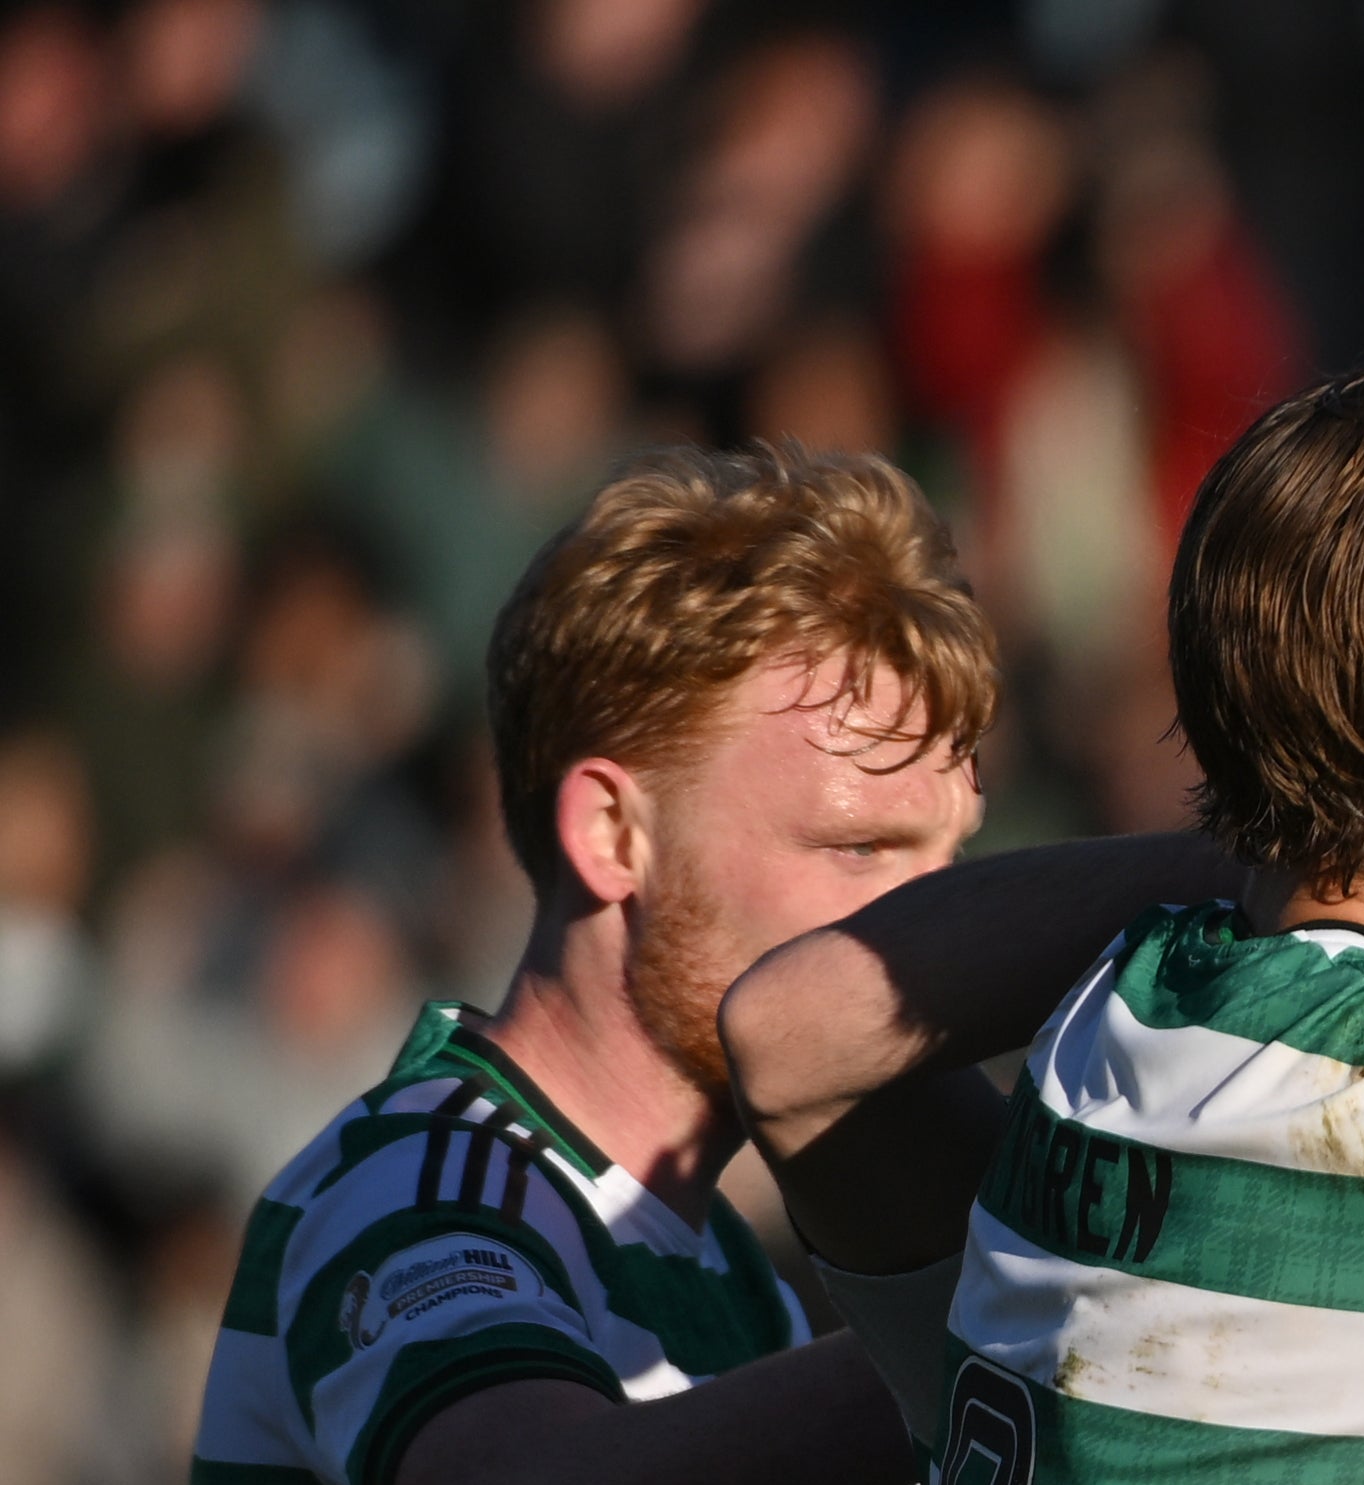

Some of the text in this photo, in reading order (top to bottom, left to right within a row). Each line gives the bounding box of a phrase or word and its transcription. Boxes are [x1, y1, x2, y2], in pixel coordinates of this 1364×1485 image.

[462, 1249, 513, 1271] HILL
[396, 1270, 507, 1310] PREMIERSHIP
[405, 1285, 503, 1321] CHAMPIONS
